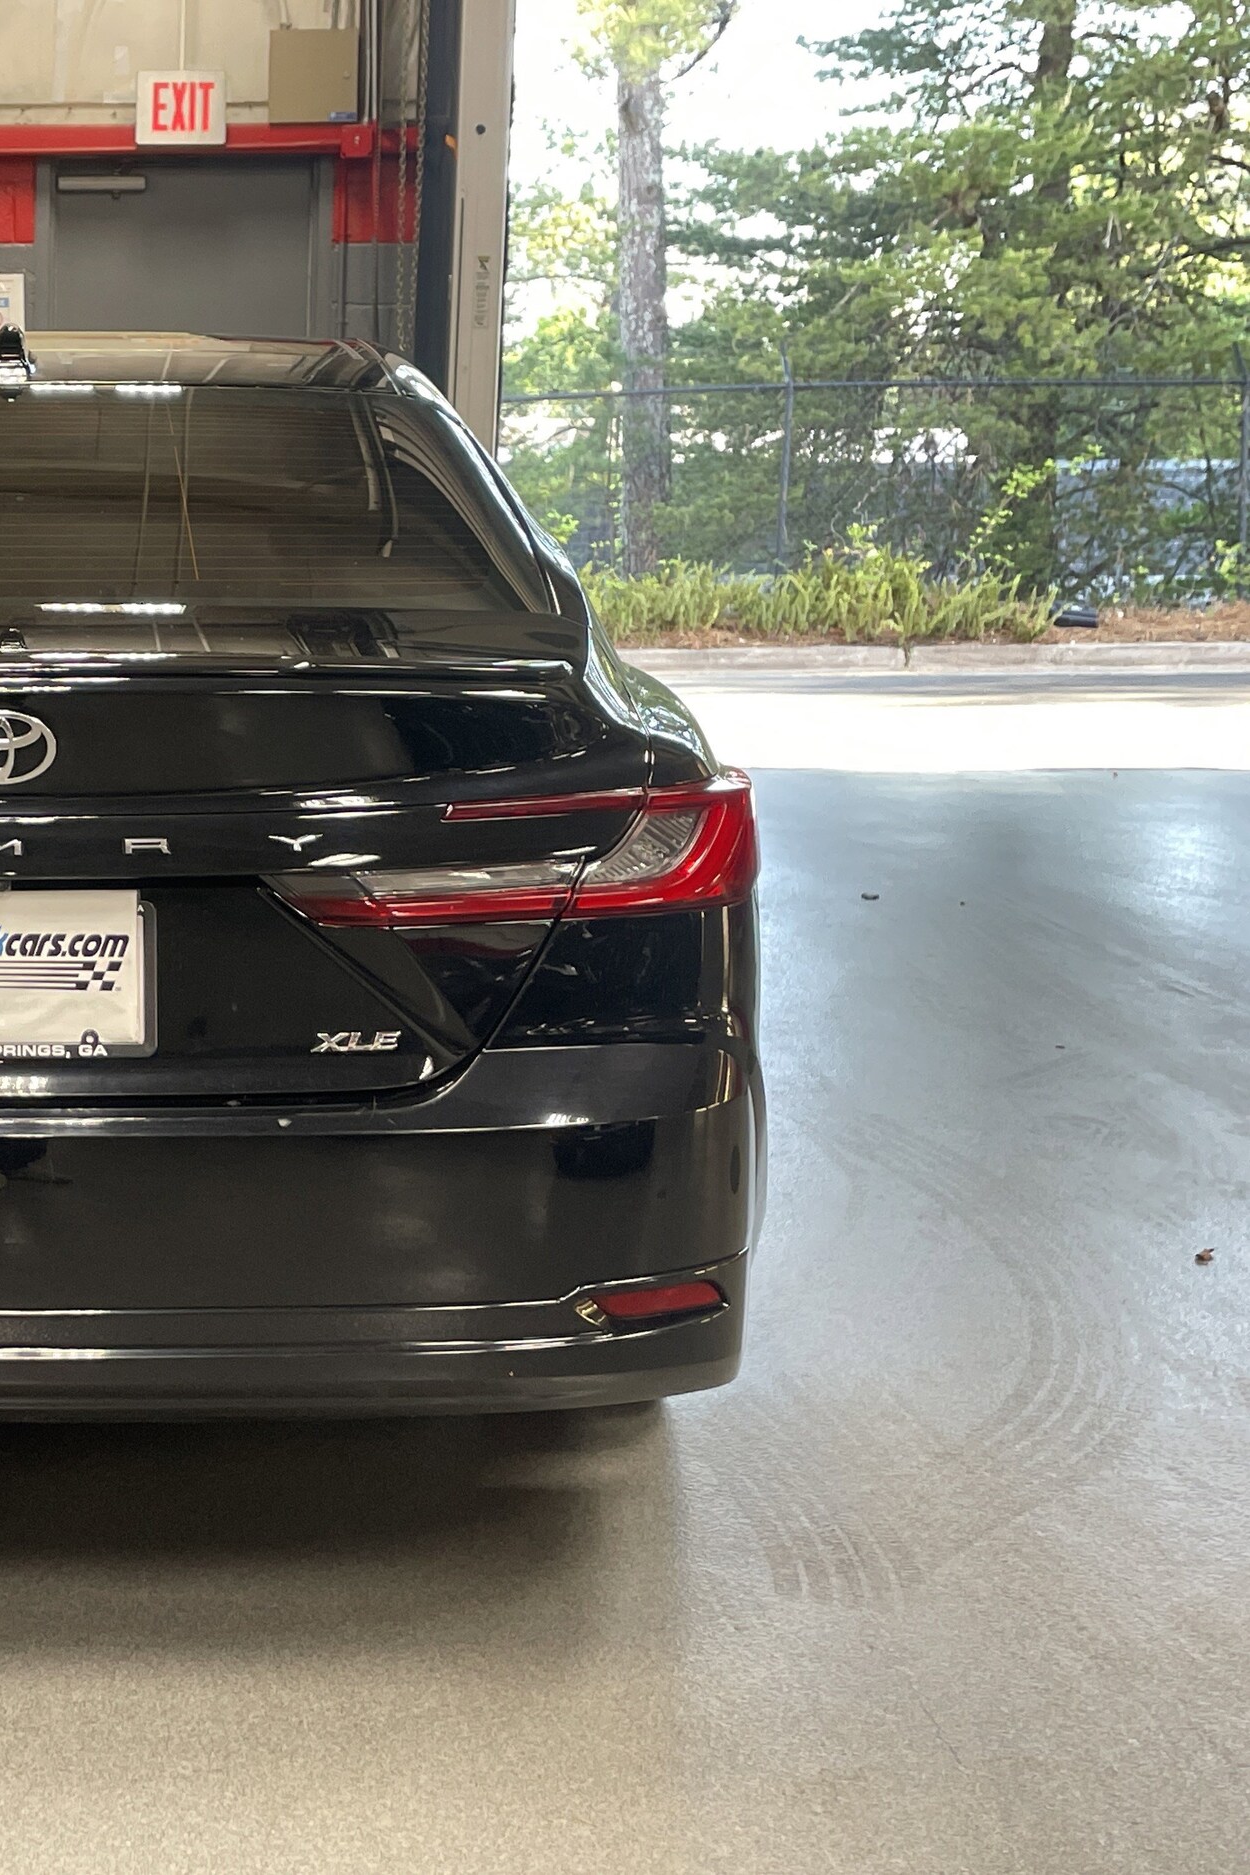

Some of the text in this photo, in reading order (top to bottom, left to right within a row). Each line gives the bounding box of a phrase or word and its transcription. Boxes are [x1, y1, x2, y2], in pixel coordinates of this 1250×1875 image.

[152, 82, 215, 132] EXIT
[77, 1044, 109, 1059] GA
[310, 1030, 402, 1053] XLE
